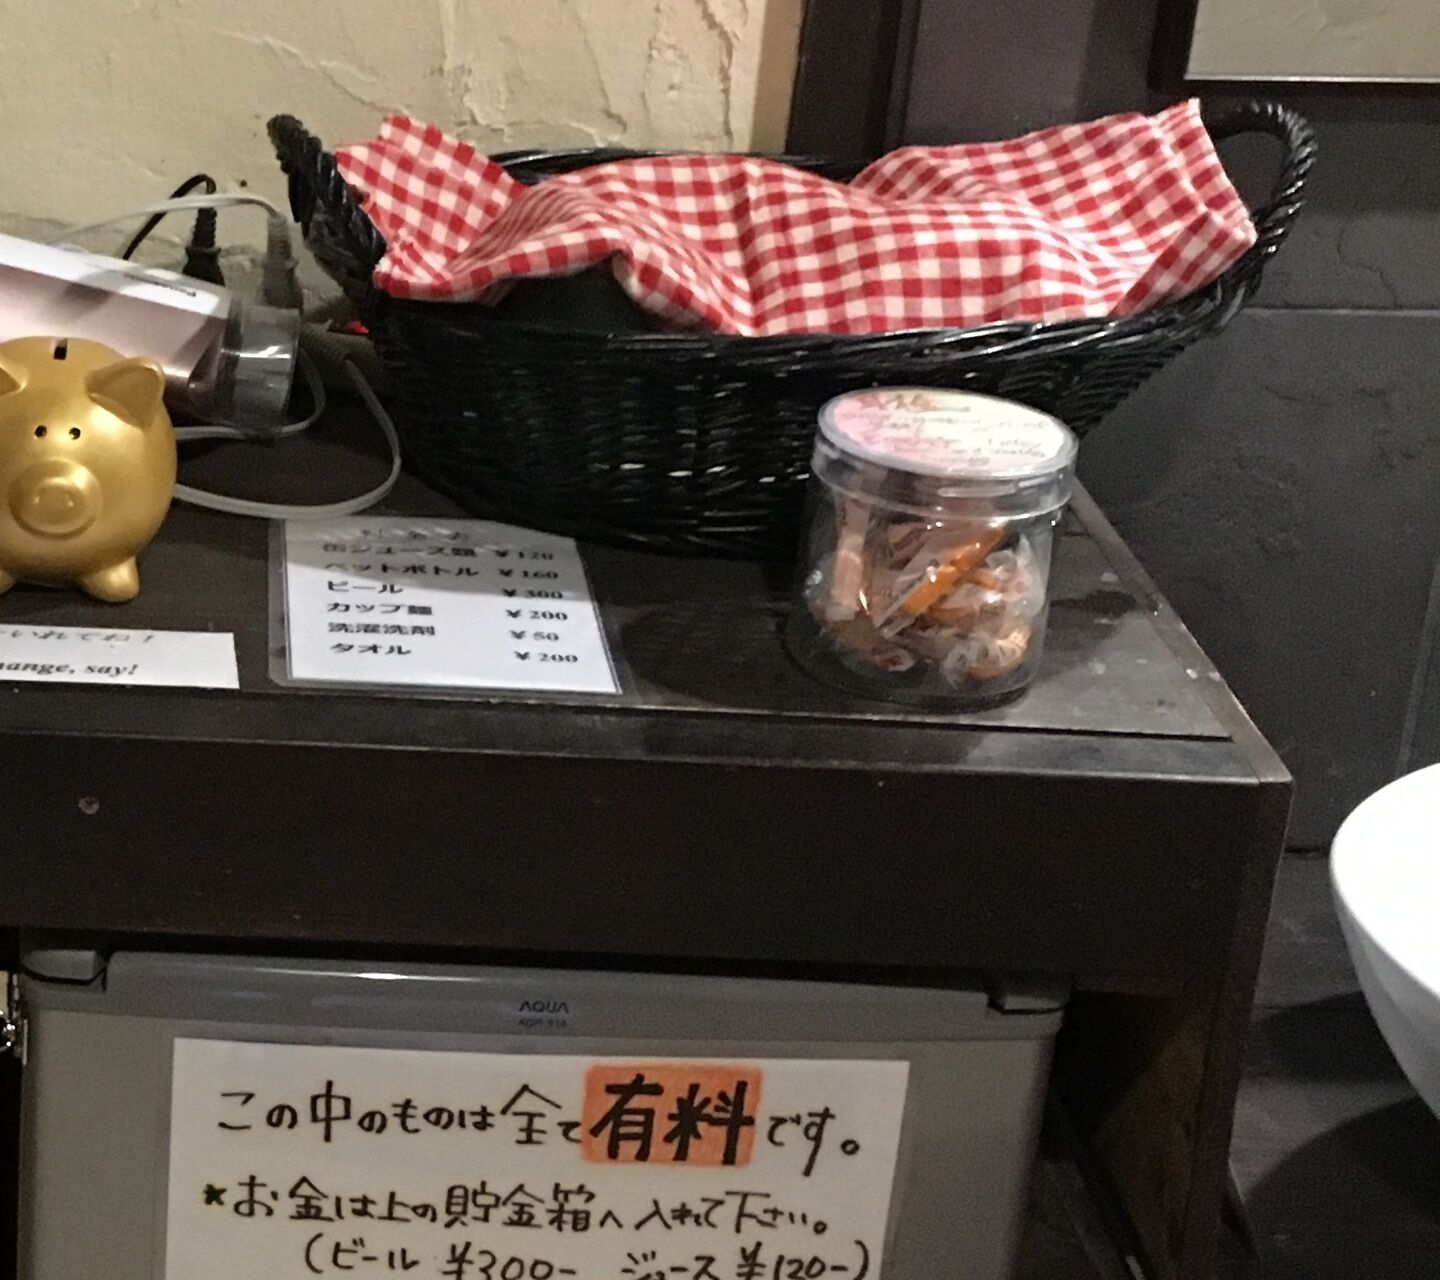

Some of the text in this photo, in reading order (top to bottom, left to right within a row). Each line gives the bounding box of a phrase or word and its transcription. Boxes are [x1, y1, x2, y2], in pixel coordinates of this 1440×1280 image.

[326, 580, 404, 595] ビール
[329, 642, 413, 657] タオル
[85, 663, 139, 677] say!
[518, 1000, 569, 1014] AQUA
